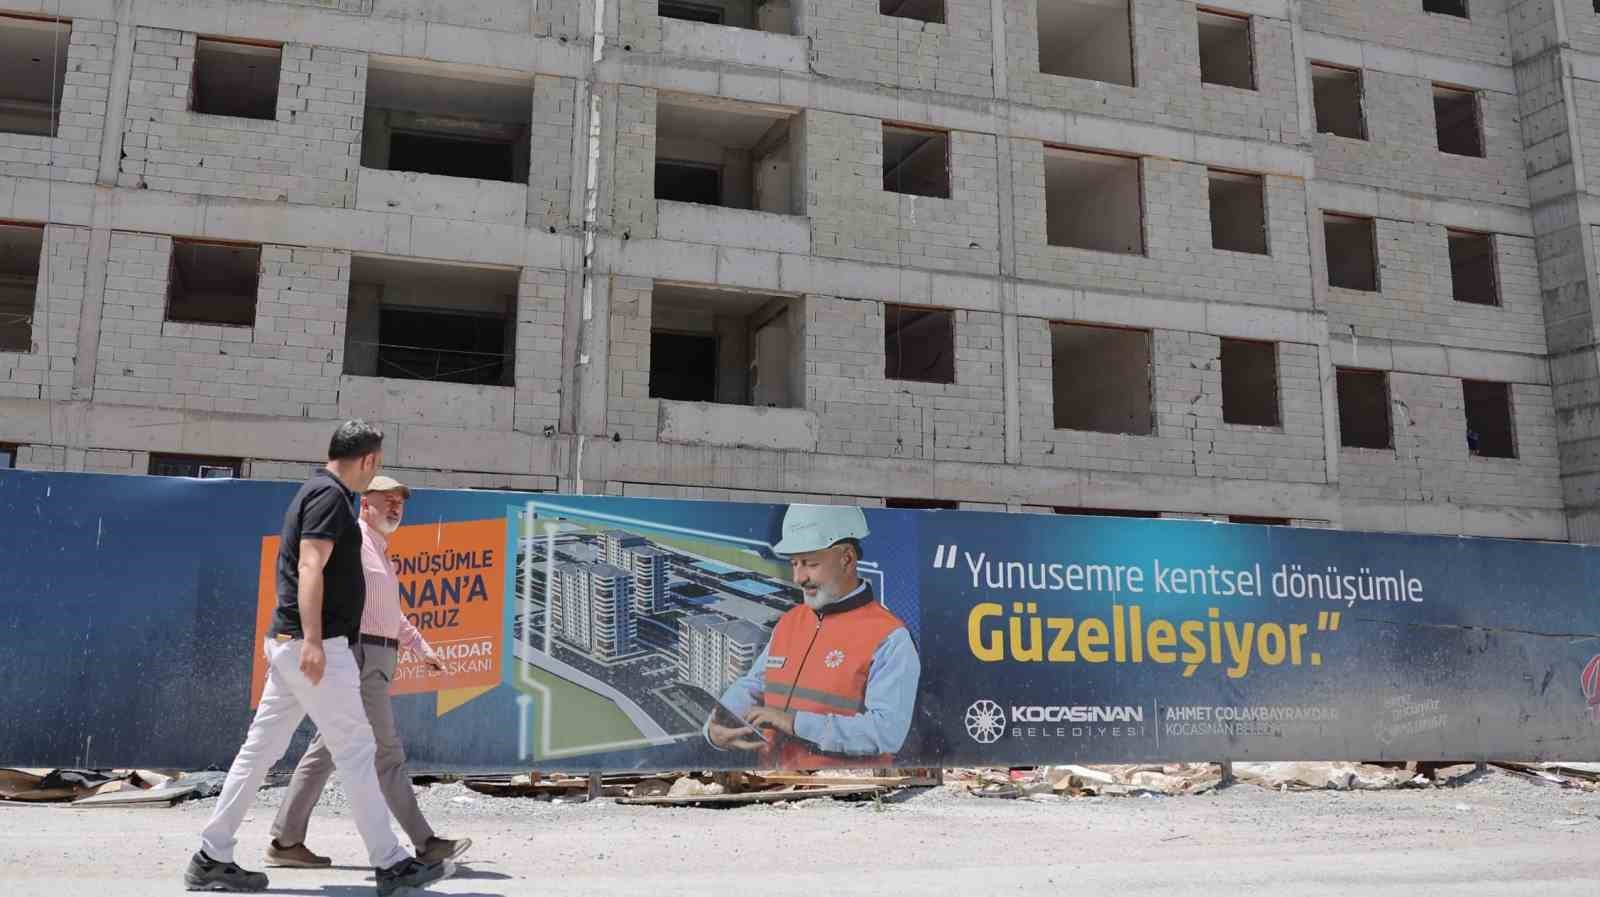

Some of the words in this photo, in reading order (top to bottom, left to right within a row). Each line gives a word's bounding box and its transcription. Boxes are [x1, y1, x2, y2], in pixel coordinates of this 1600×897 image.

[391, 550, 493, 576] ÖNÜŞÜMLE
[398, 574, 488, 608] NAN’A
[1154, 559, 1262, 597] kentsel
[1272, 564, 1424, 607] dönüşümle
[406, 608, 460, 630] ORUZ
[1166, 706, 1212, 721] AHMET
[1012, 727, 1144, 737] BELEDİYESİ
